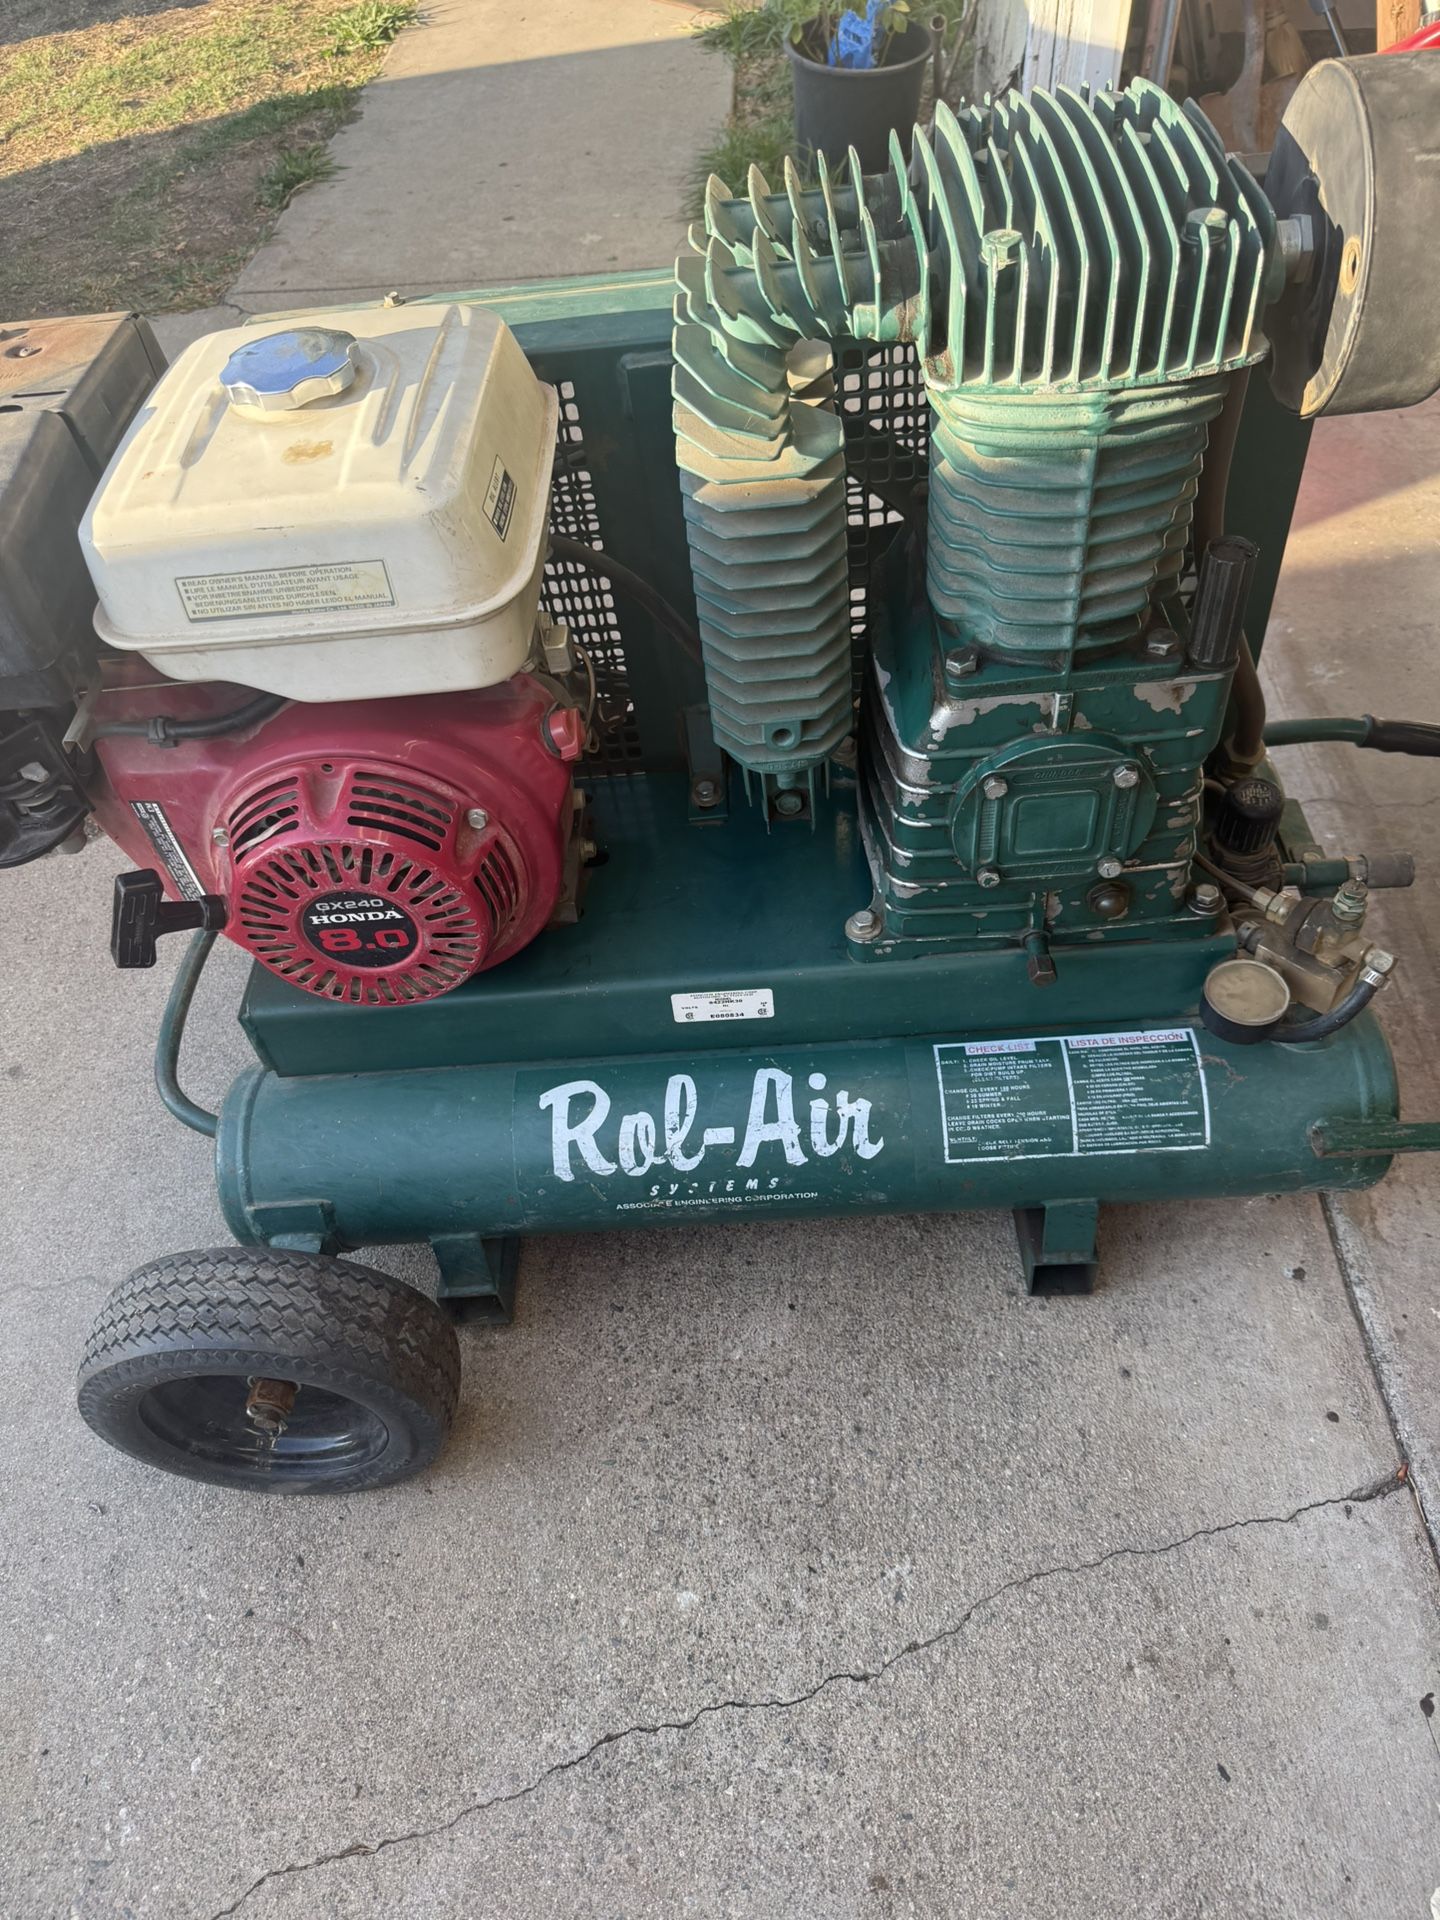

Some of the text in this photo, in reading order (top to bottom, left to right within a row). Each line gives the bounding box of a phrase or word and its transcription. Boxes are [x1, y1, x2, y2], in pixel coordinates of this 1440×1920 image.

[244, 574, 278, 582] MANUAL
[279, 570, 307, 578] BEFORE
[309, 566, 352, 576] OPERATION
[315, 898, 384, 911] GX240
[309, 910, 404, 925] HONDA
[318, 928, 410, 952] 8.0
[1119, 1032, 1184, 1044] INSPECCIÓN
[968, 1043, 1030, 1054] CHECK LIST
[538, 1068, 885, 1182] Rol-Air
